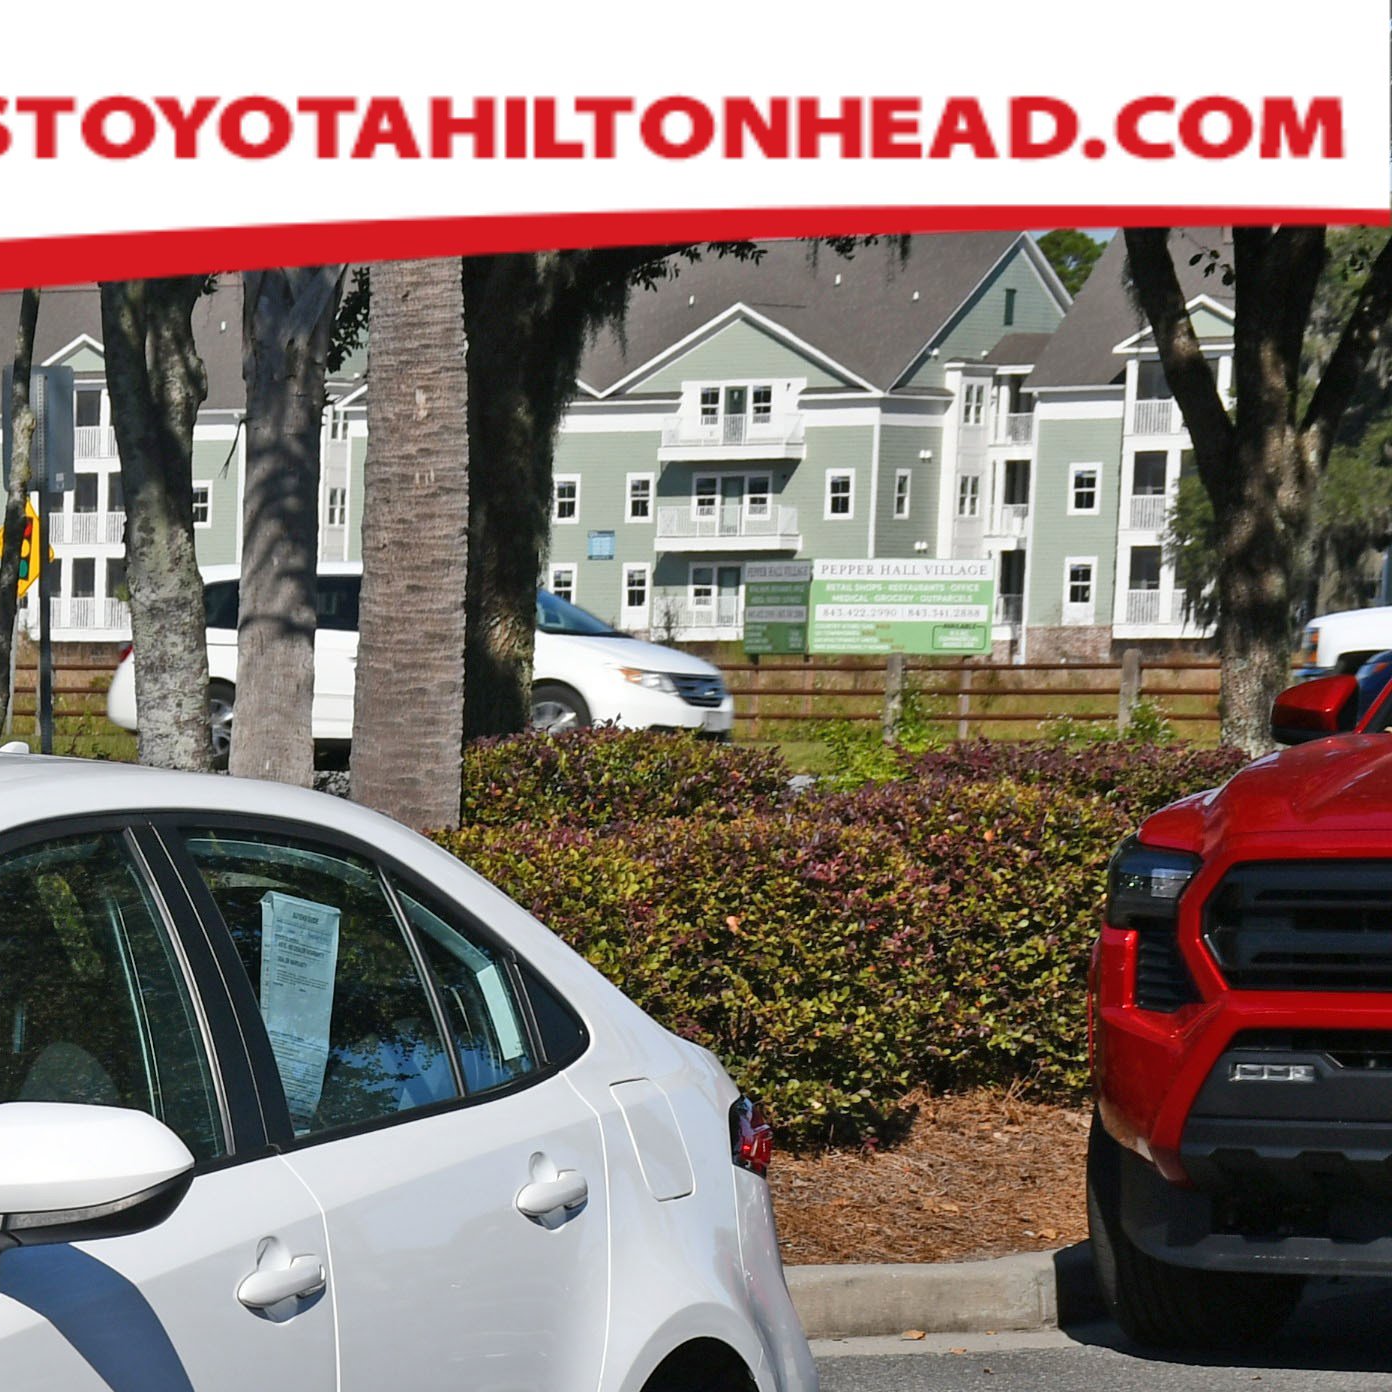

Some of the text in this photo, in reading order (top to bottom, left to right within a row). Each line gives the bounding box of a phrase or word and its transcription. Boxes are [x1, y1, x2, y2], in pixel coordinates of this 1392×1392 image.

[821, 564, 988, 576] PEPPER HALL VILLAGE
